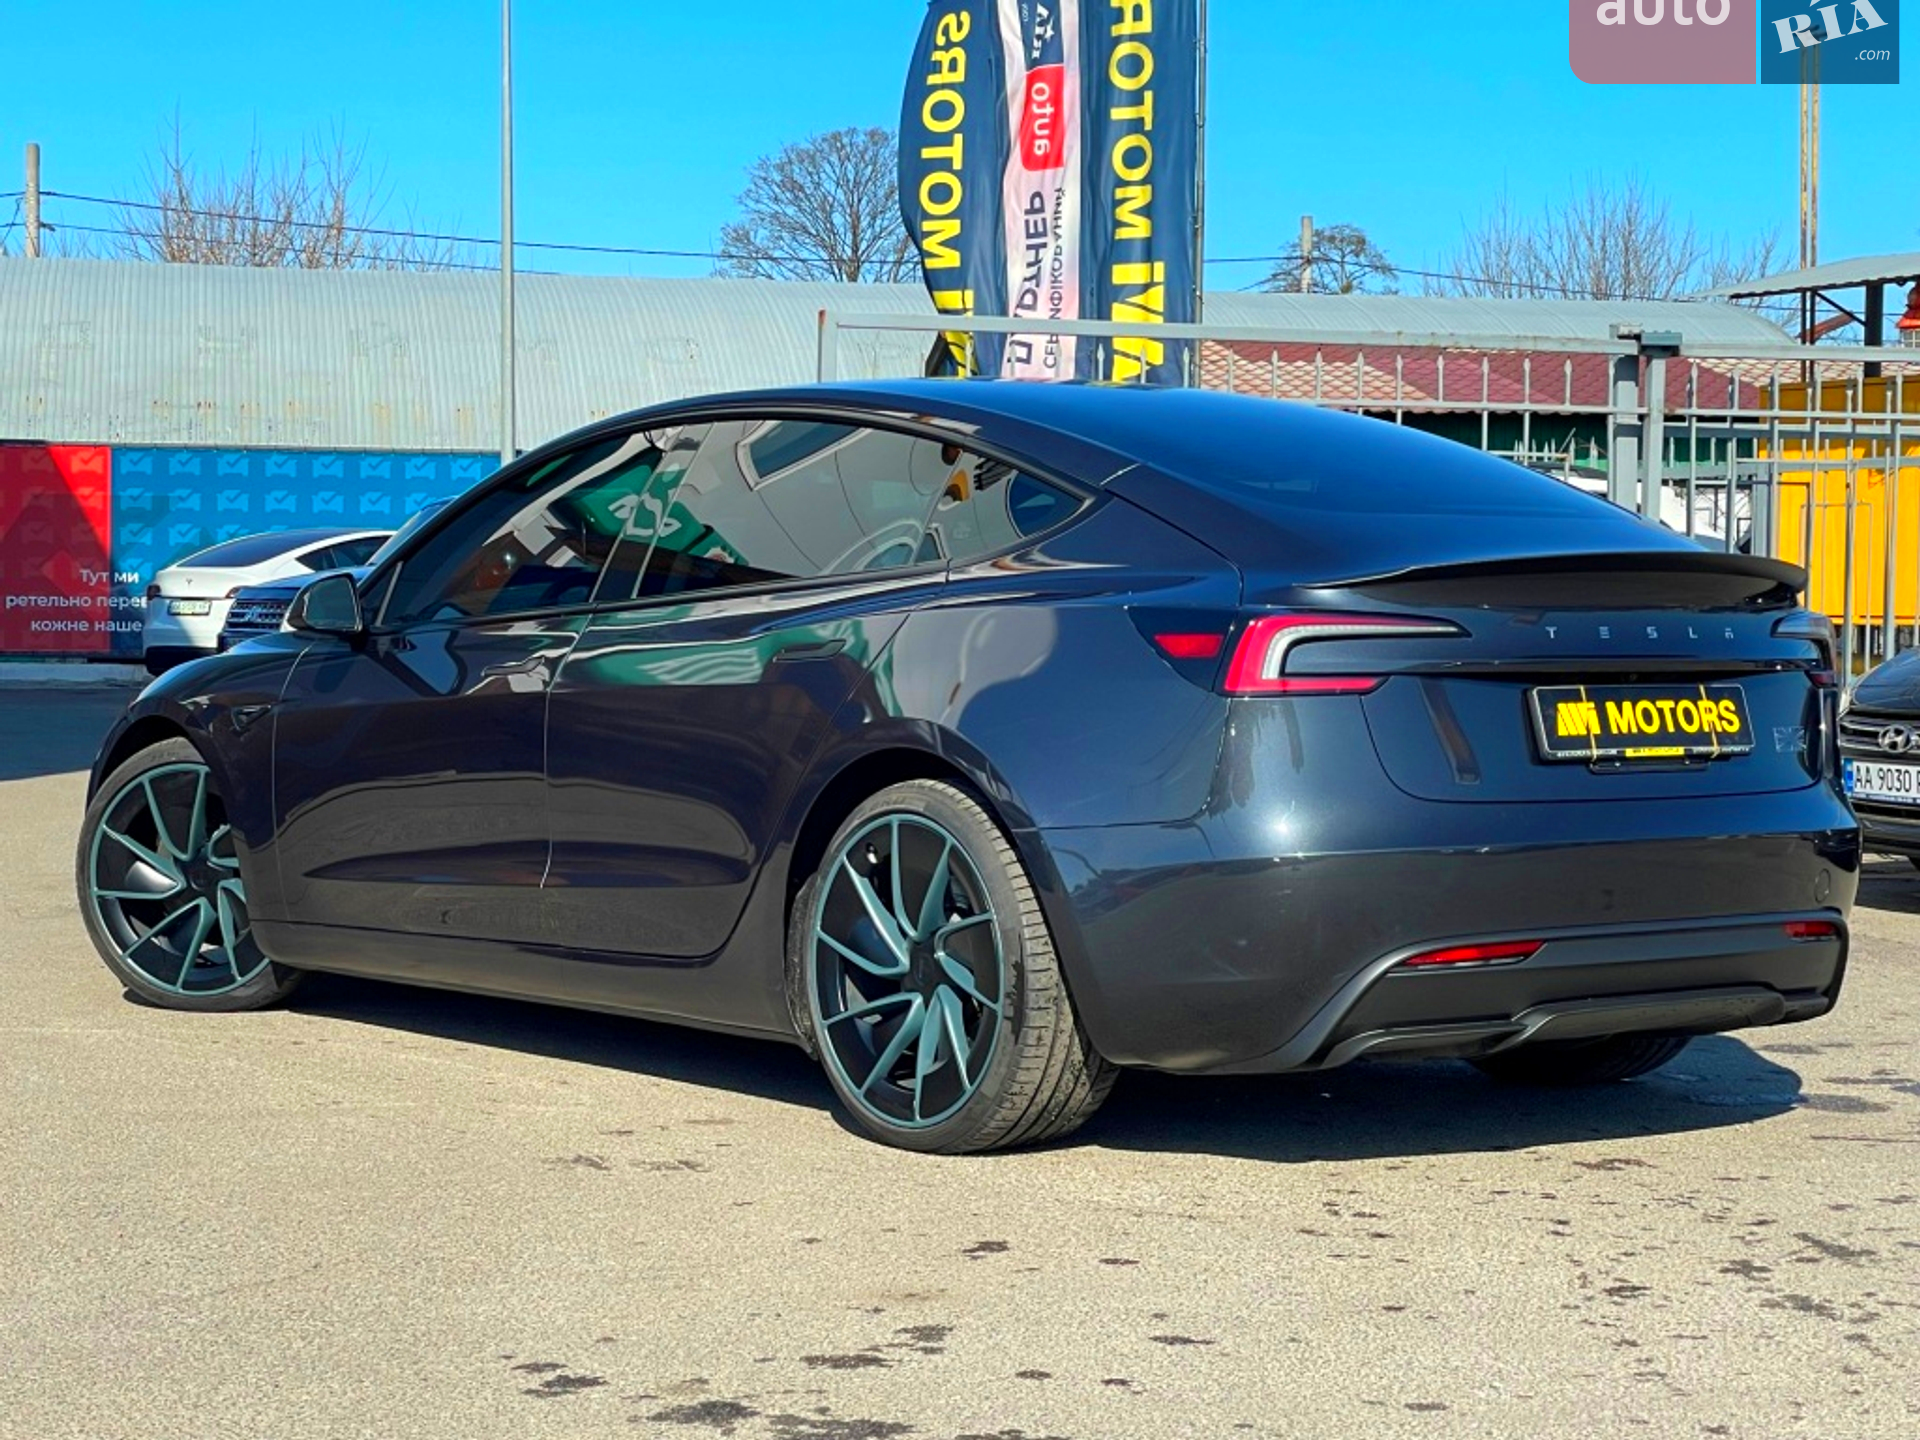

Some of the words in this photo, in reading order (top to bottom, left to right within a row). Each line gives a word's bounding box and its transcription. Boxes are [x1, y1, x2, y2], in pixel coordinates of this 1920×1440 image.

[80, 569, 109, 586] Тут
[114, 572, 139, 584] ми
[6, 595, 92, 609] ретельно
[31, 620, 89, 632] кожне
[94, 620, 143, 632] наше
[1545, 626, 1734, 639] TESLA
[1605, 700, 1741, 735] MOTORS
[1855, 764, 1874, 790] AA
[1877, 766, 1912, 793] 9030
